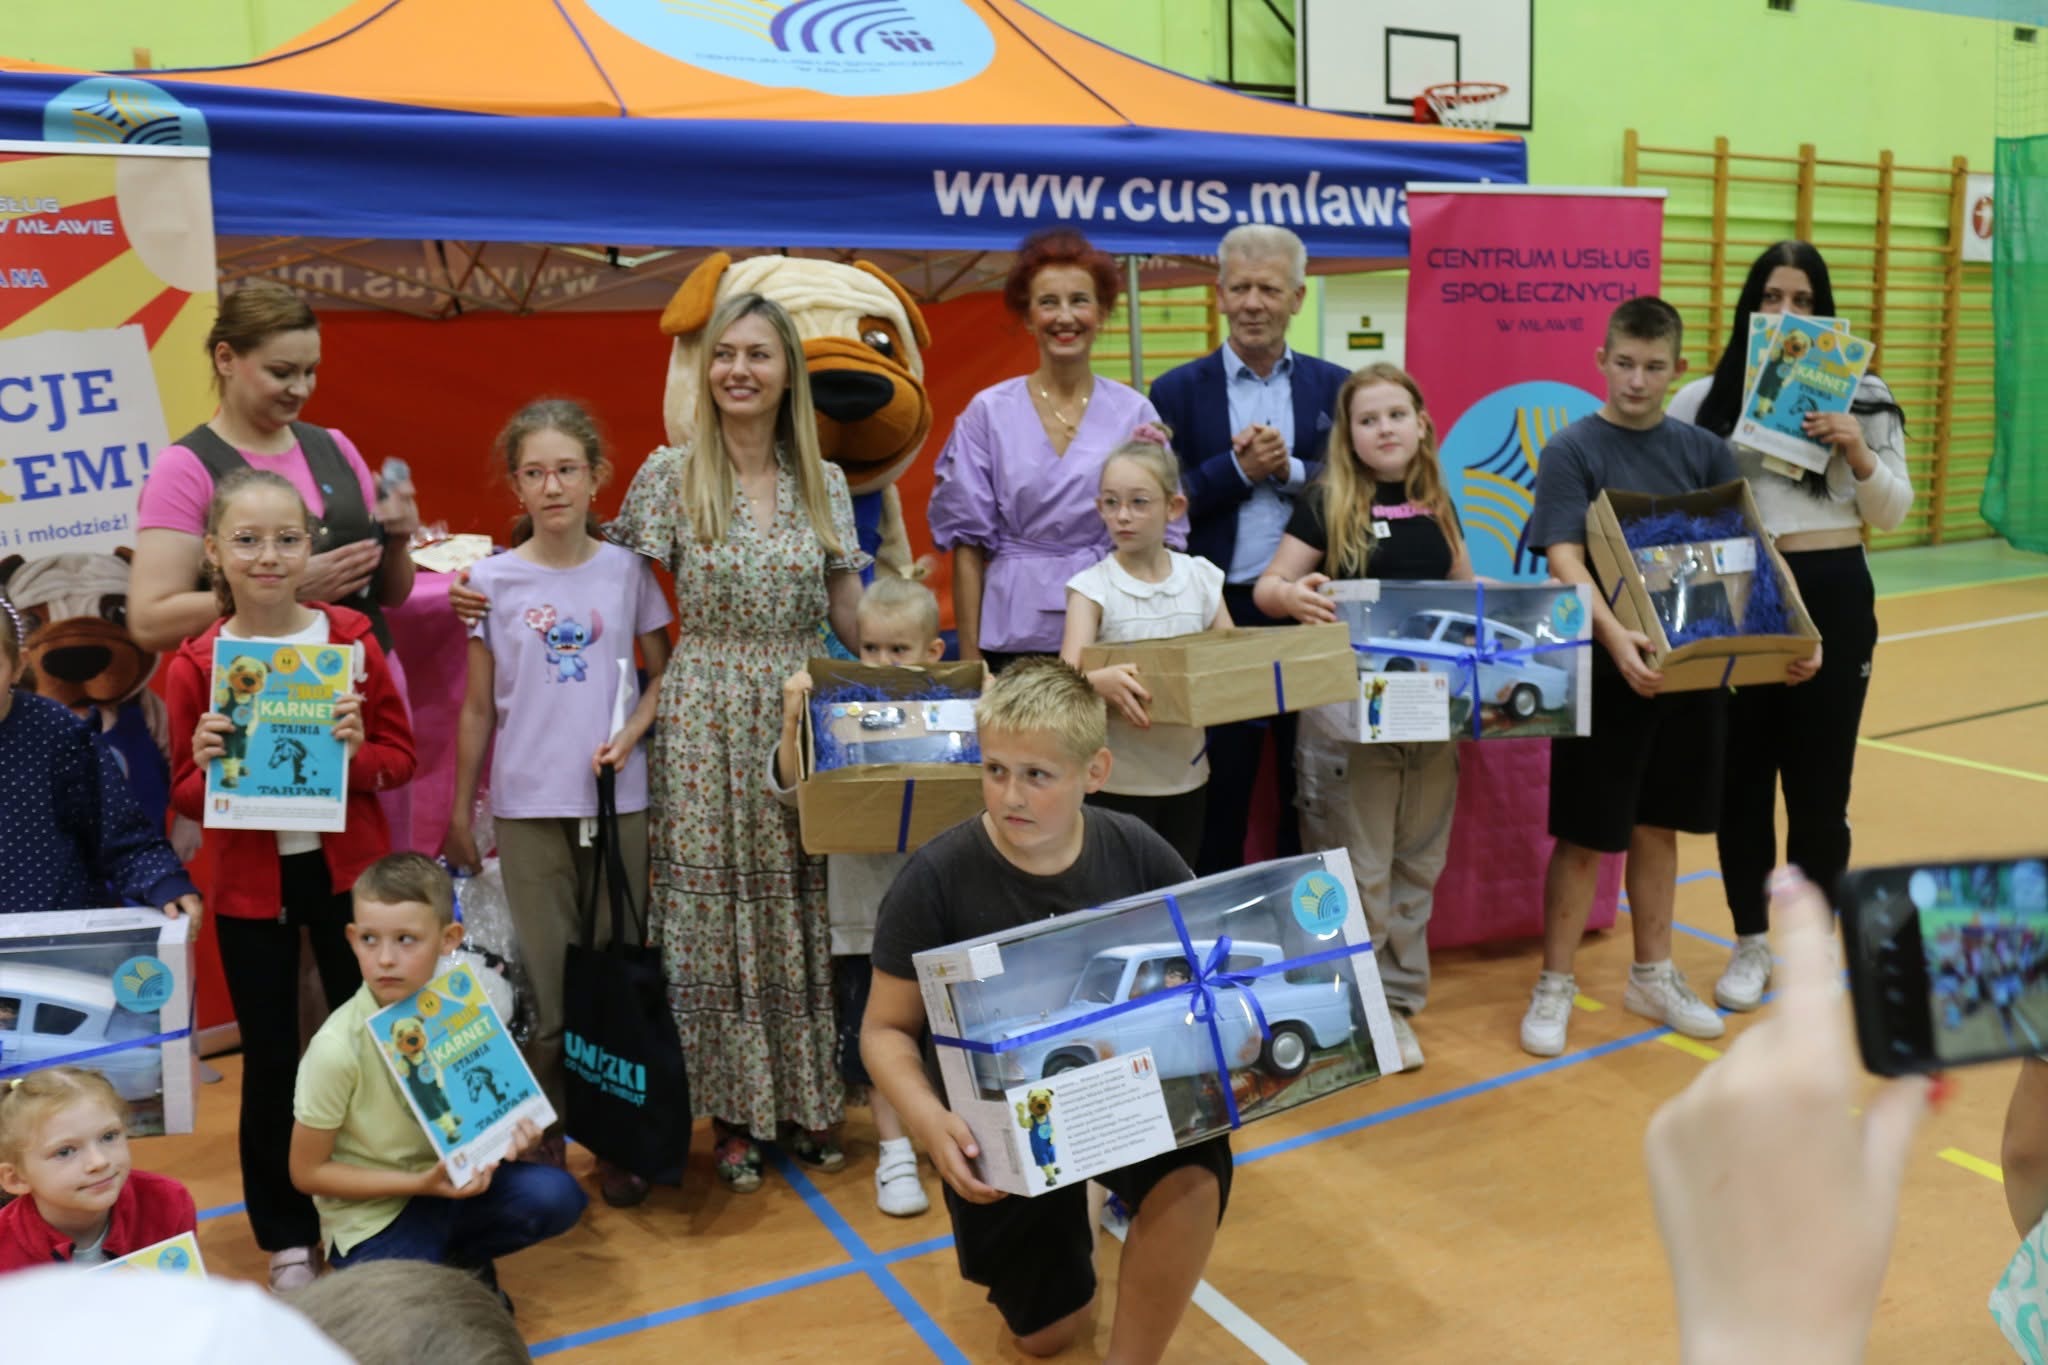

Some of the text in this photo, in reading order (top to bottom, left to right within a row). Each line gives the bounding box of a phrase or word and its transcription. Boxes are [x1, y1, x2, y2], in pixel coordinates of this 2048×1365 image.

[15, 219, 114, 236] MŁAWIE
[1427, 249, 1651, 269] CENTRUM USŁUG
[1441, 282, 1637, 304] SPOŁECZNYCH
[1496, 317, 1584, 331] W MŁAWIE
[28, 513, 129, 543] młodzież!
[432, 1015, 492, 1063] KARNET
